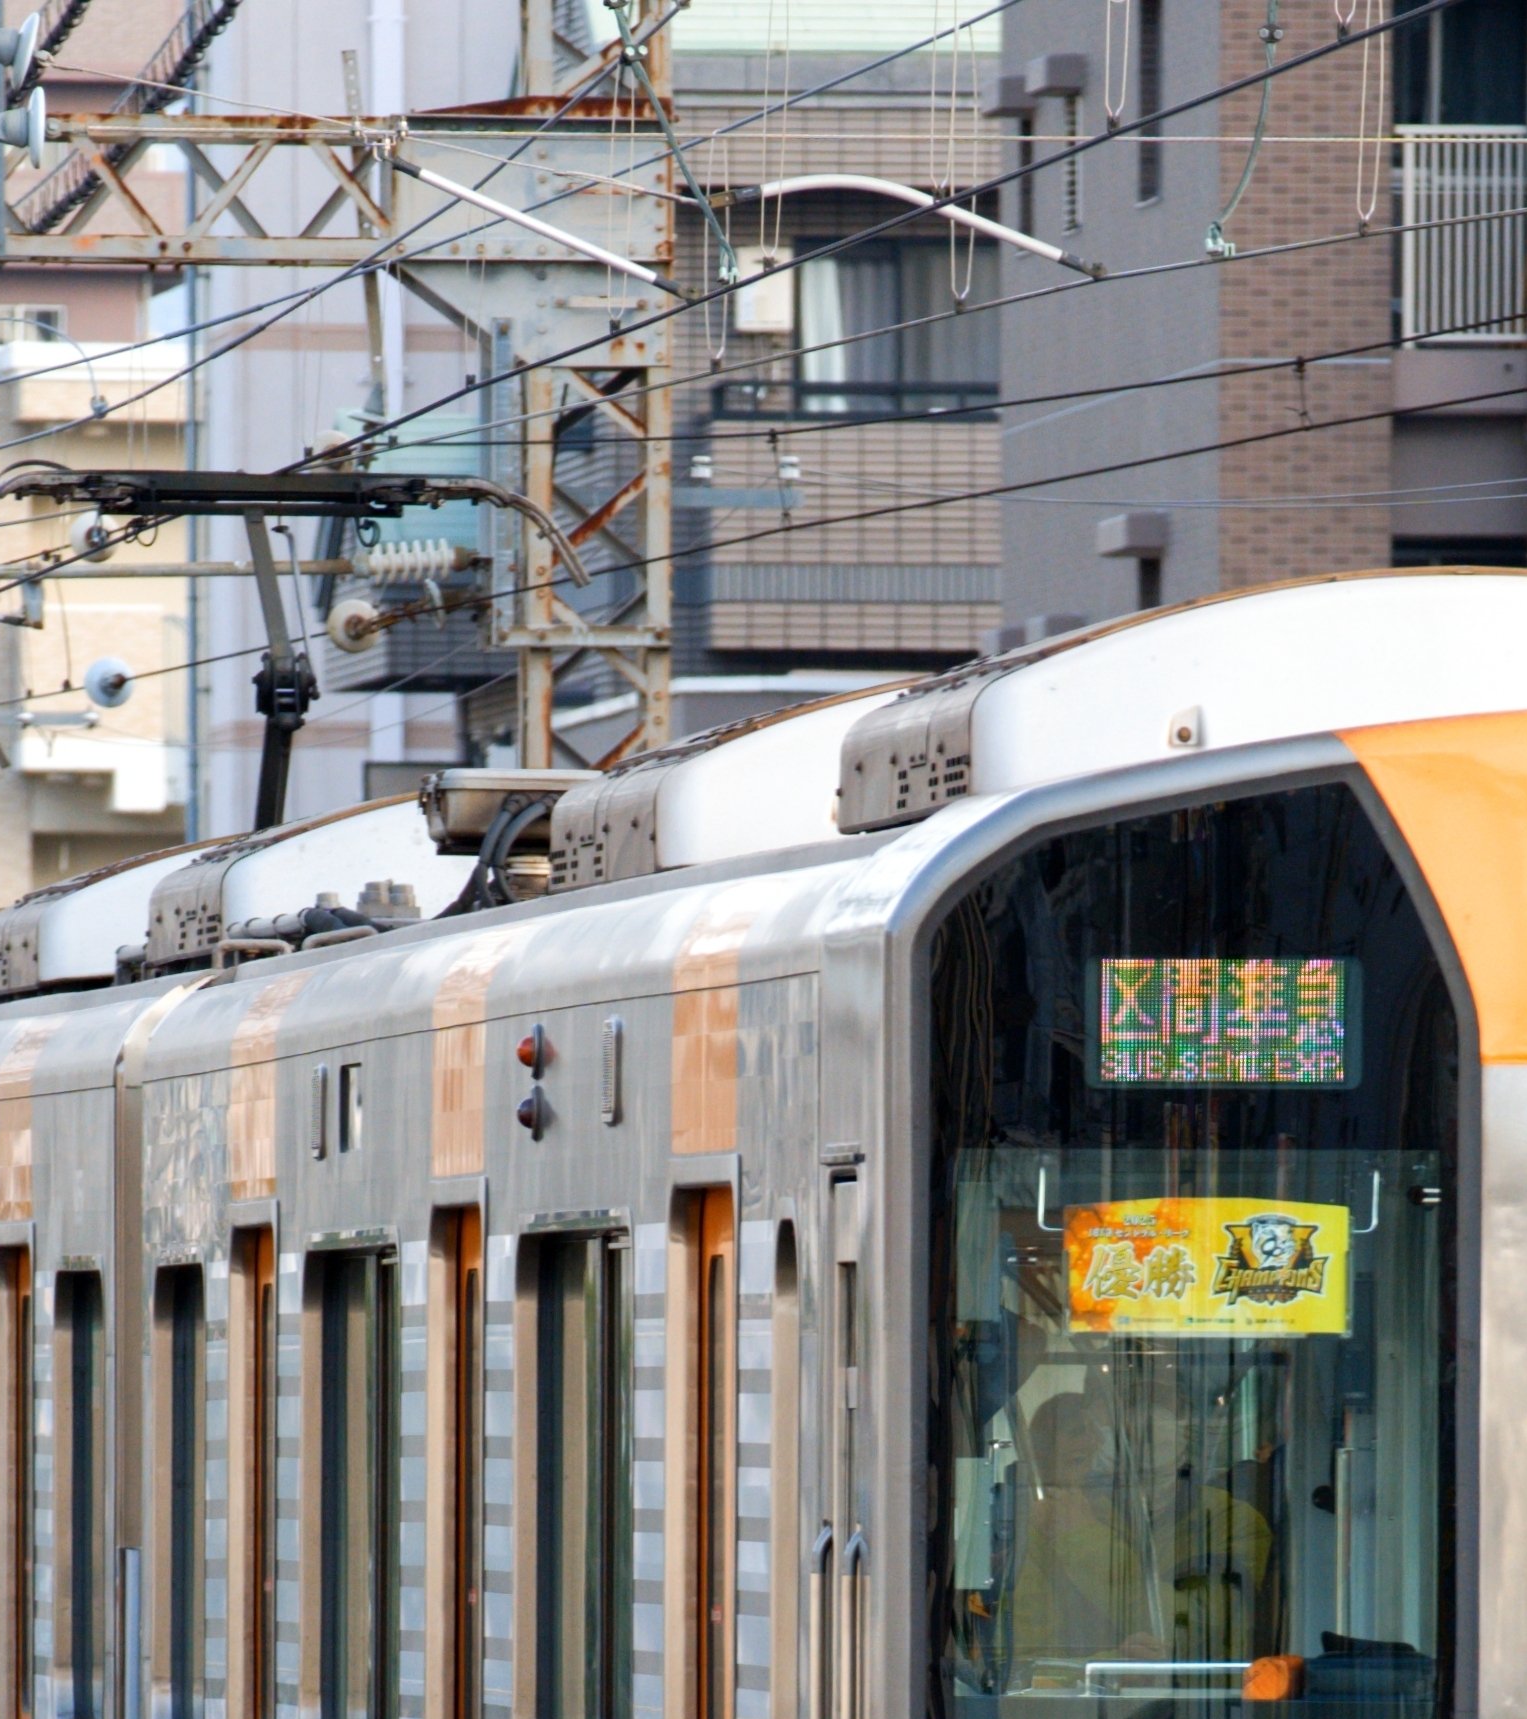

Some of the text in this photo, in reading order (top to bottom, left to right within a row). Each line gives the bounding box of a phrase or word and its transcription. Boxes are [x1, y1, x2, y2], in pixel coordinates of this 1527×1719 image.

[1102, 959, 1344, 1043] 区間準急
[1083, 1241, 1197, 1300] 優勝
